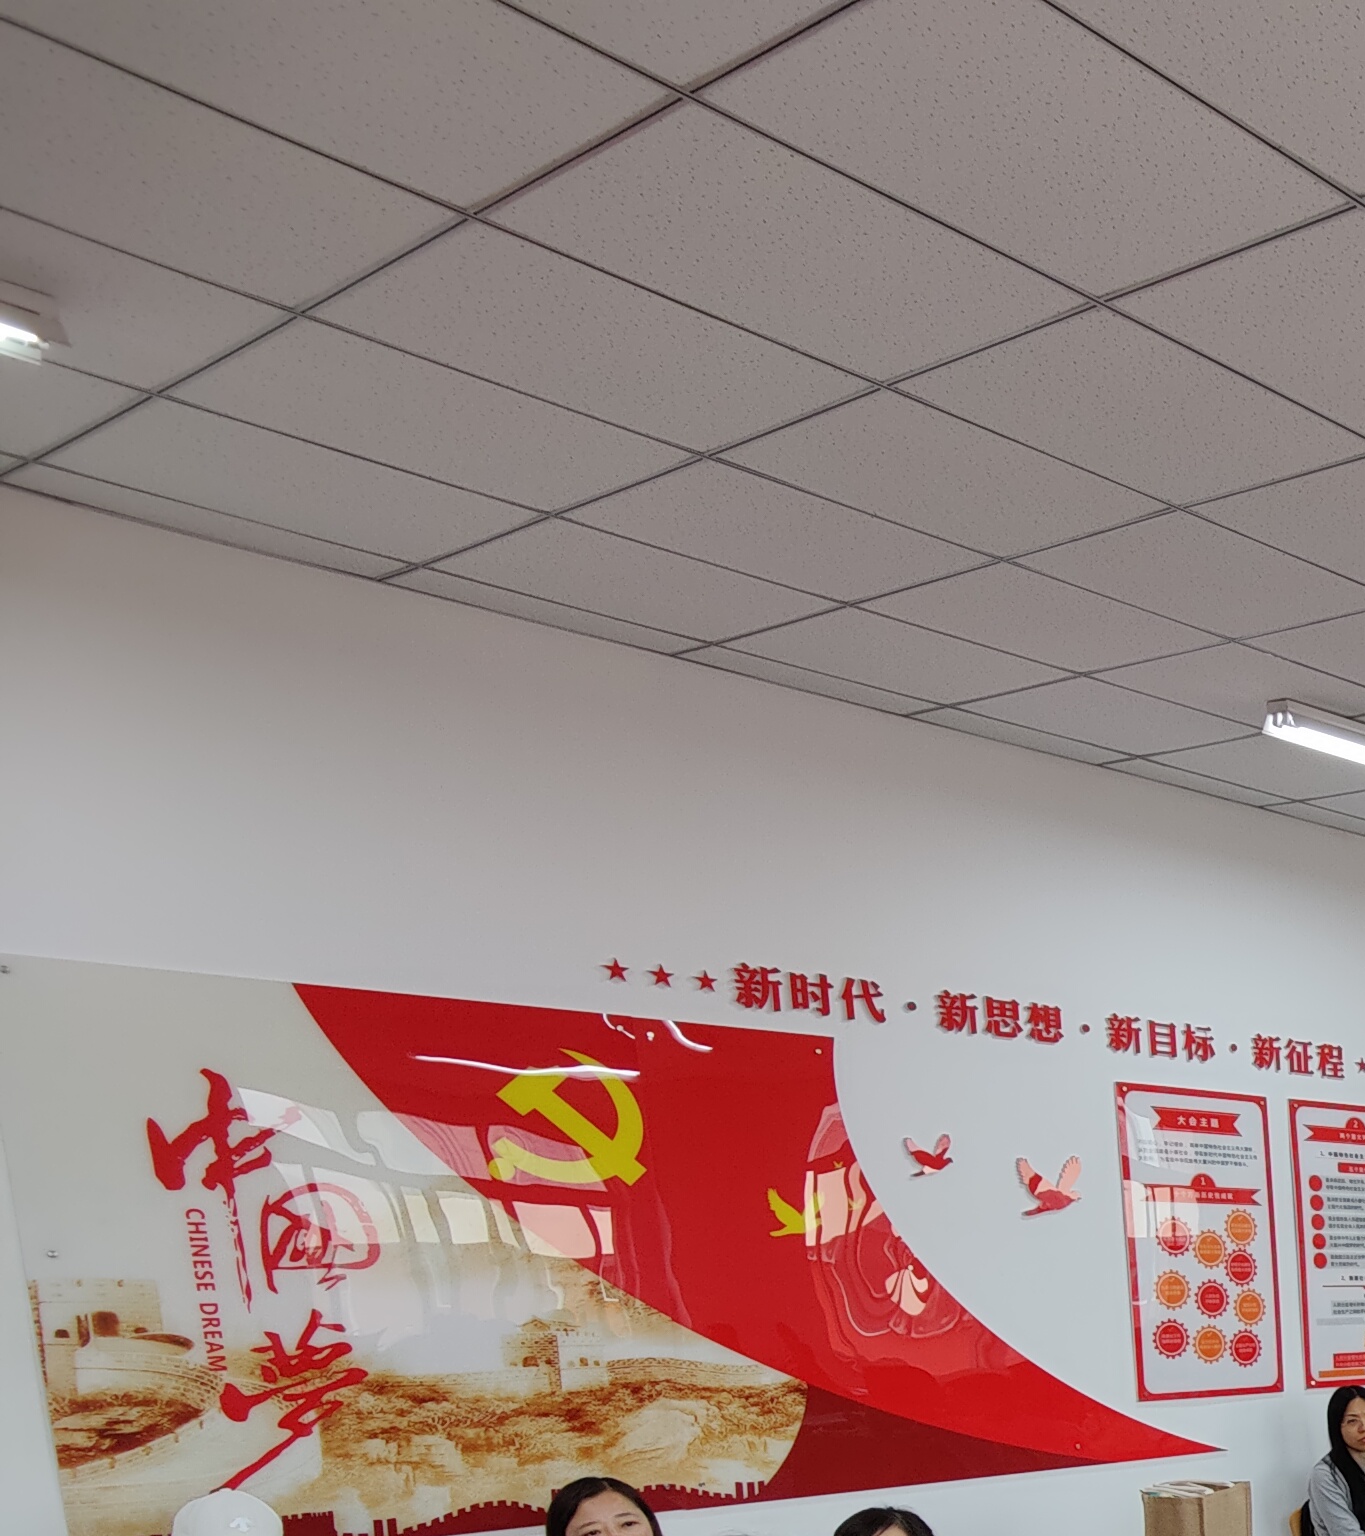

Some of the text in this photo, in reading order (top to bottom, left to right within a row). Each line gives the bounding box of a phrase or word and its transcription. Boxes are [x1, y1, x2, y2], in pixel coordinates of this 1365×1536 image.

[1177, 1115, 1220, 1128] 大会主题
[1200, 1177, 1205, 1185] 1
[184, 1208, 228, 1373] CHINESE DREAM
